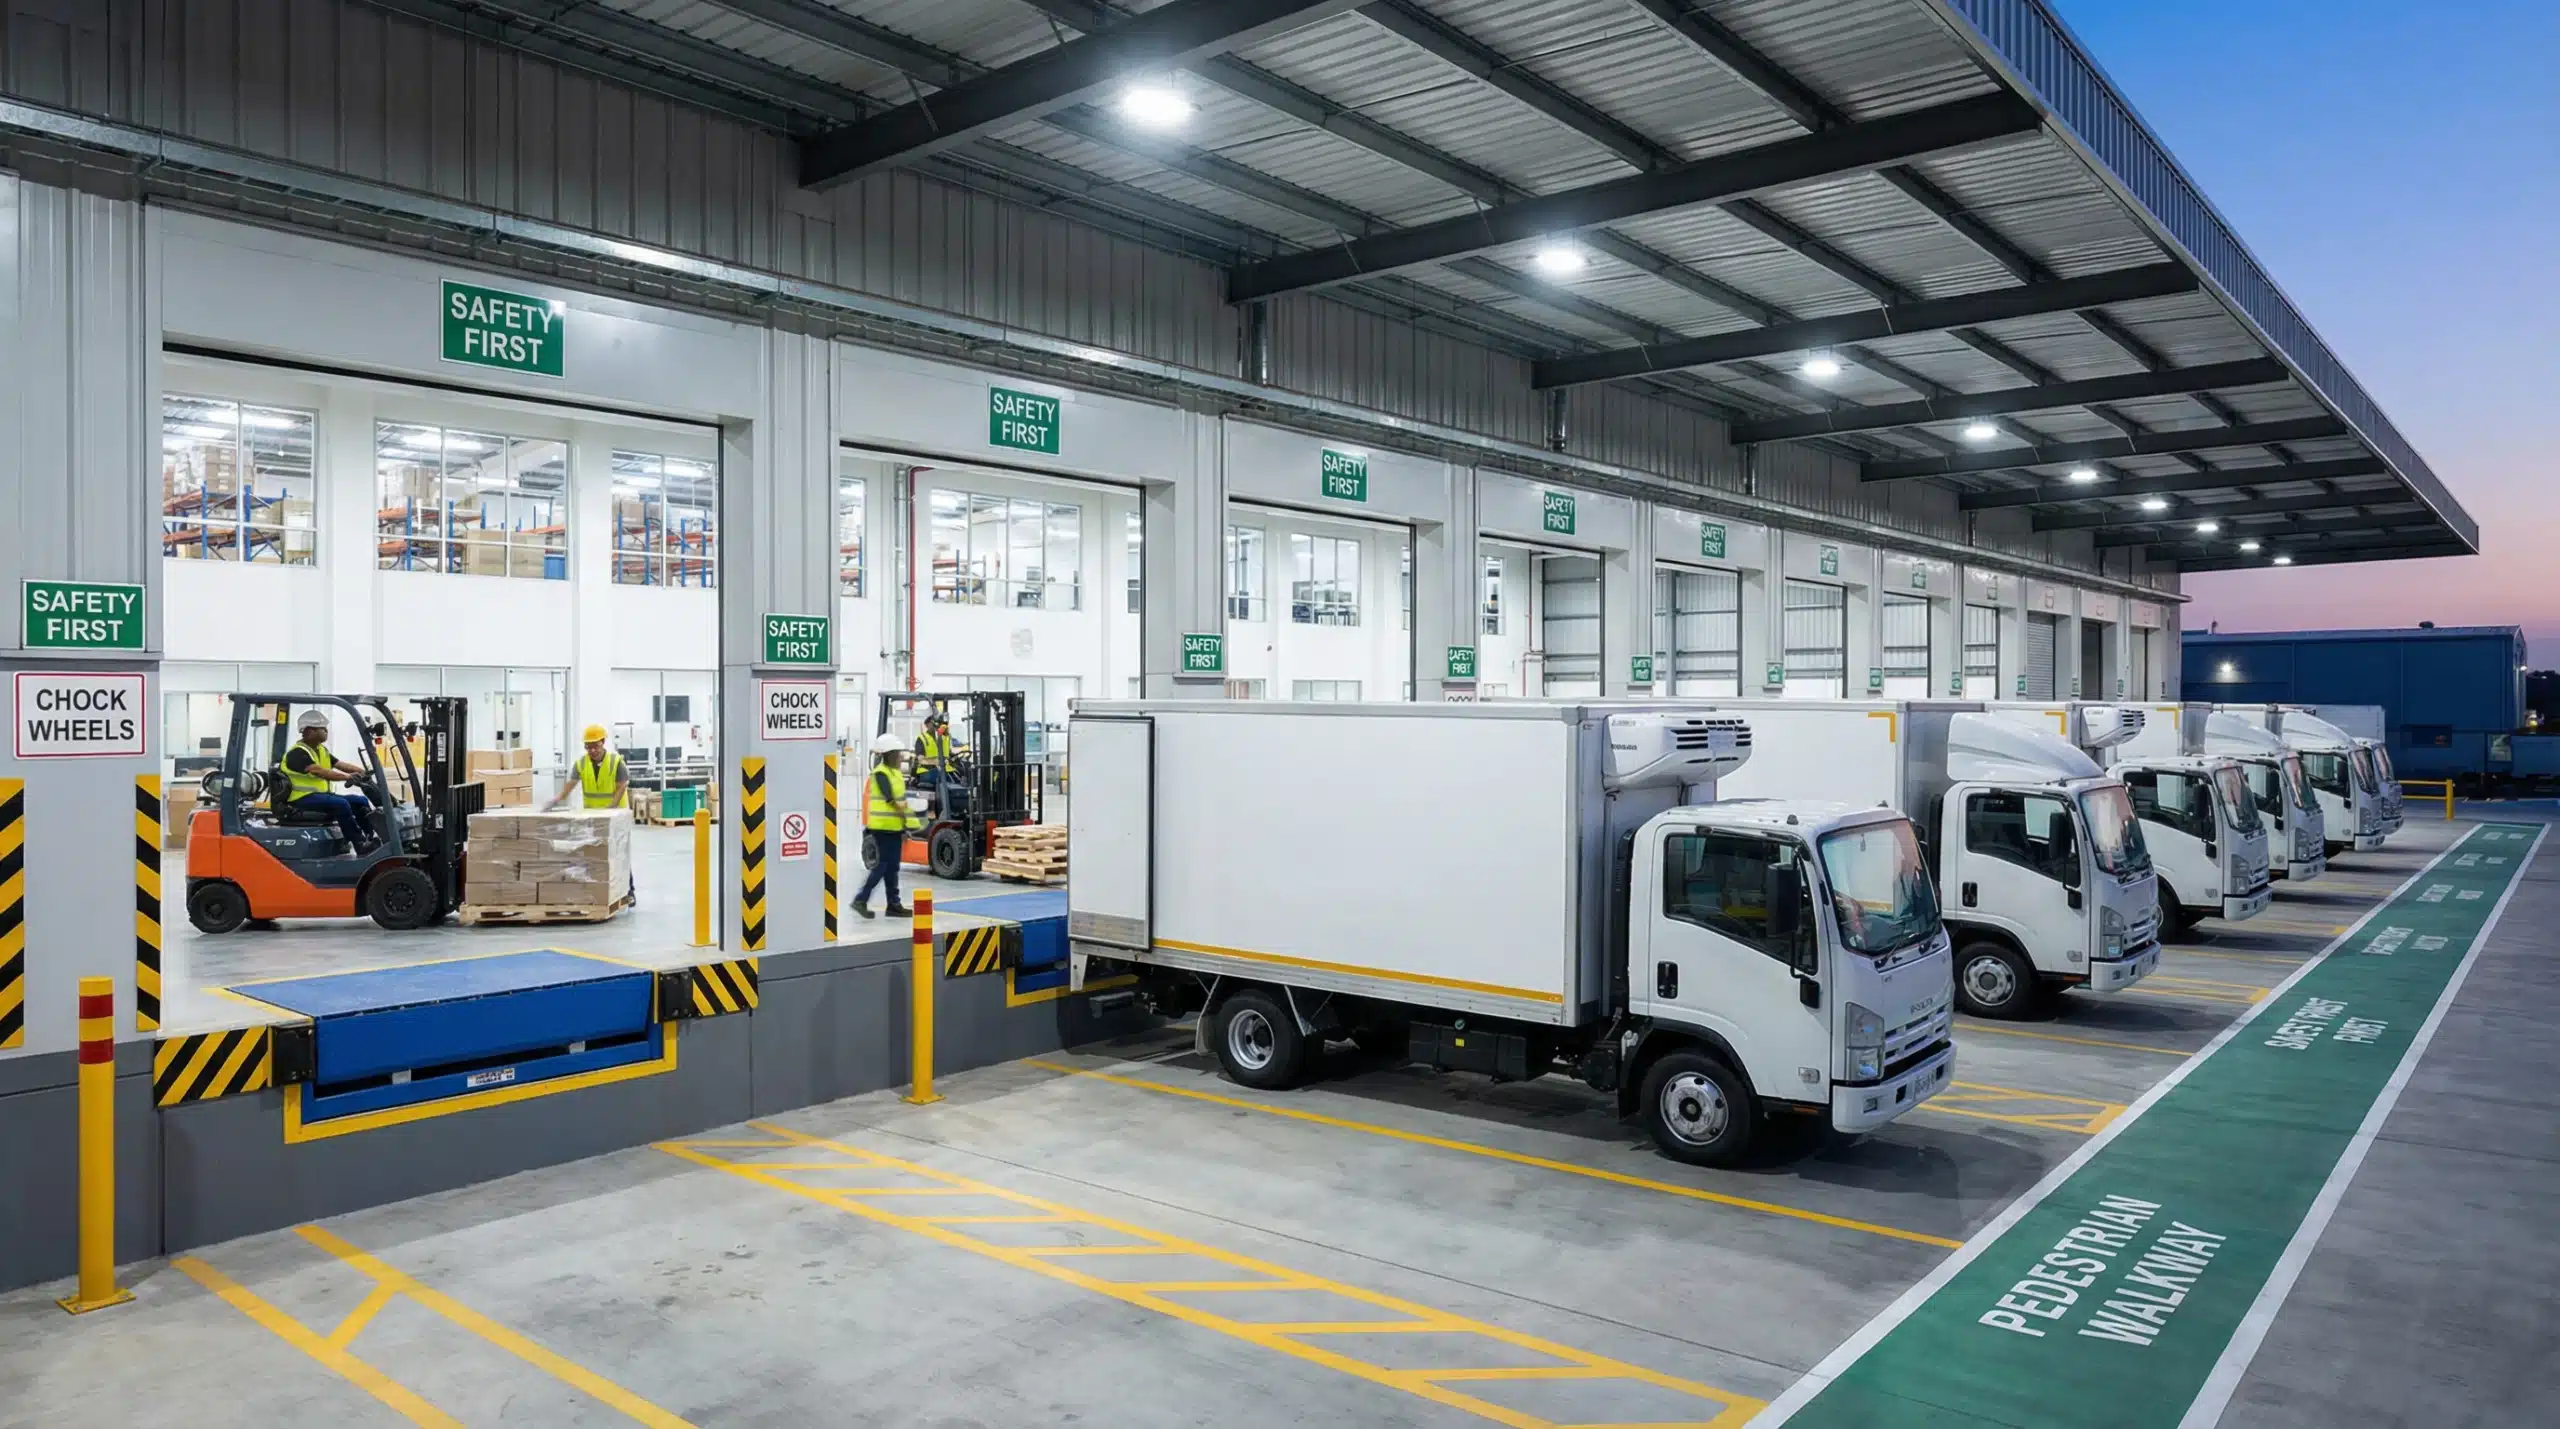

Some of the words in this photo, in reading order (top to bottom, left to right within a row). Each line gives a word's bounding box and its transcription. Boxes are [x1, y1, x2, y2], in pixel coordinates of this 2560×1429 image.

[451, 291, 554, 335] SAFETY
[463, 326, 544, 366] FIRST
[991, 391, 1056, 424] SAFETY
[1001, 419, 1049, 448] FIRST
[1323, 454, 1366, 477] SAFETY
[1328, 475, 1360, 497] FIRST
[32, 589, 136, 615] SAFETY
[47, 618, 124, 642] FIRST
[768, 620, 826, 640] SAFETY
[776, 641, 819, 660] FIRST
[1184, 637, 1221, 652] SAFETY
[36, 688, 127, 712] CHOCK
[770, 691, 820, 711] CHOCK
[27, 718, 135, 742] WHEELS
[766, 712, 824, 730] WHEELS
[1977, 1193, 2163, 1338] PEDESTRIAN
[2077, 1220, 2228, 1347] WALKWAY
